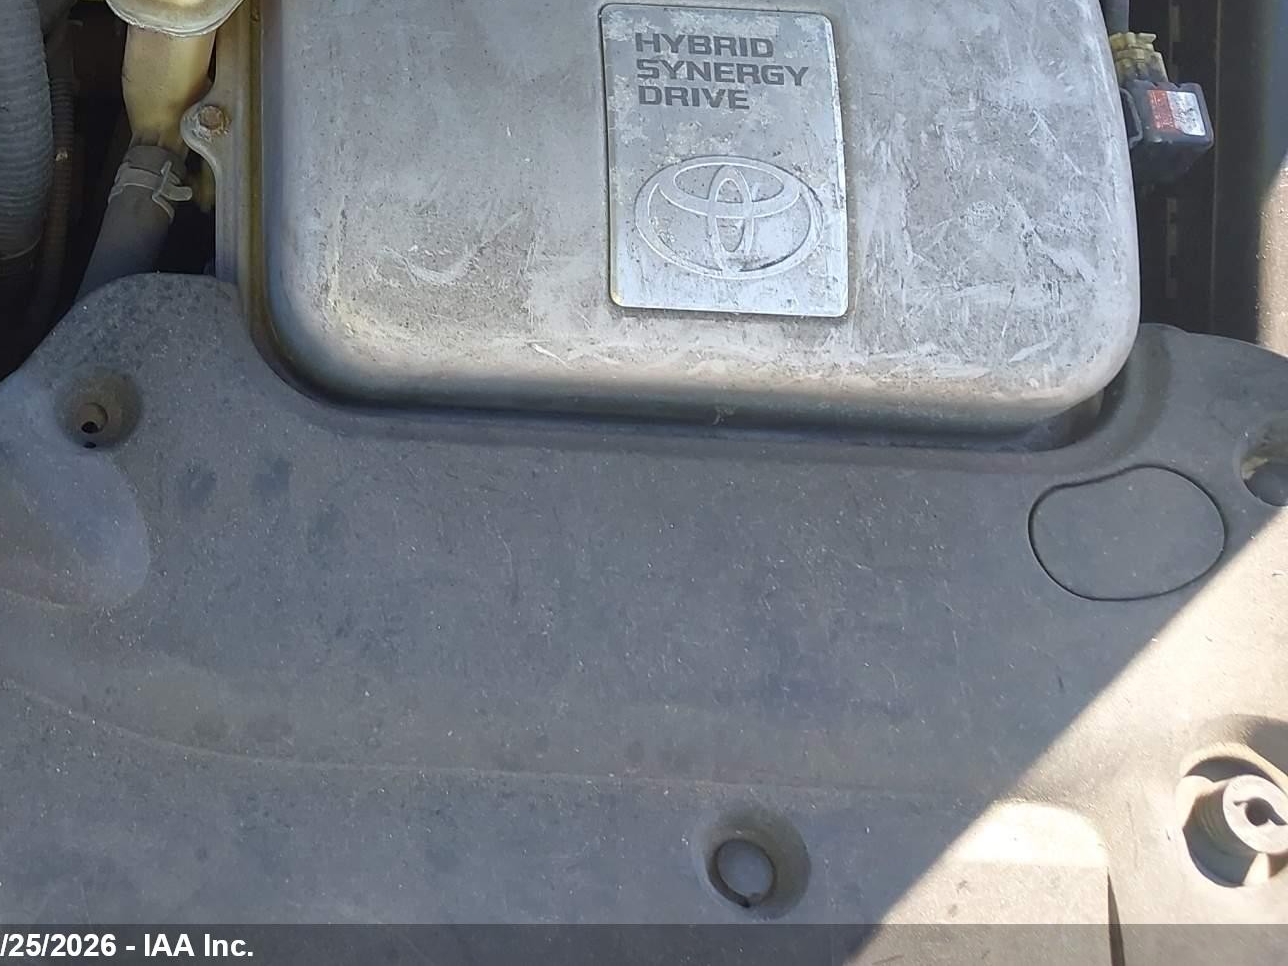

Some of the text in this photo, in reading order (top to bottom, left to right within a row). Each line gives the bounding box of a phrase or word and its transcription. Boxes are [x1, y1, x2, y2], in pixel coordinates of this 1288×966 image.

[634, 32, 775, 58] HYBRID
[636, 58, 809, 87] SYNERGY
[638, 85, 751, 110] DRIVE
